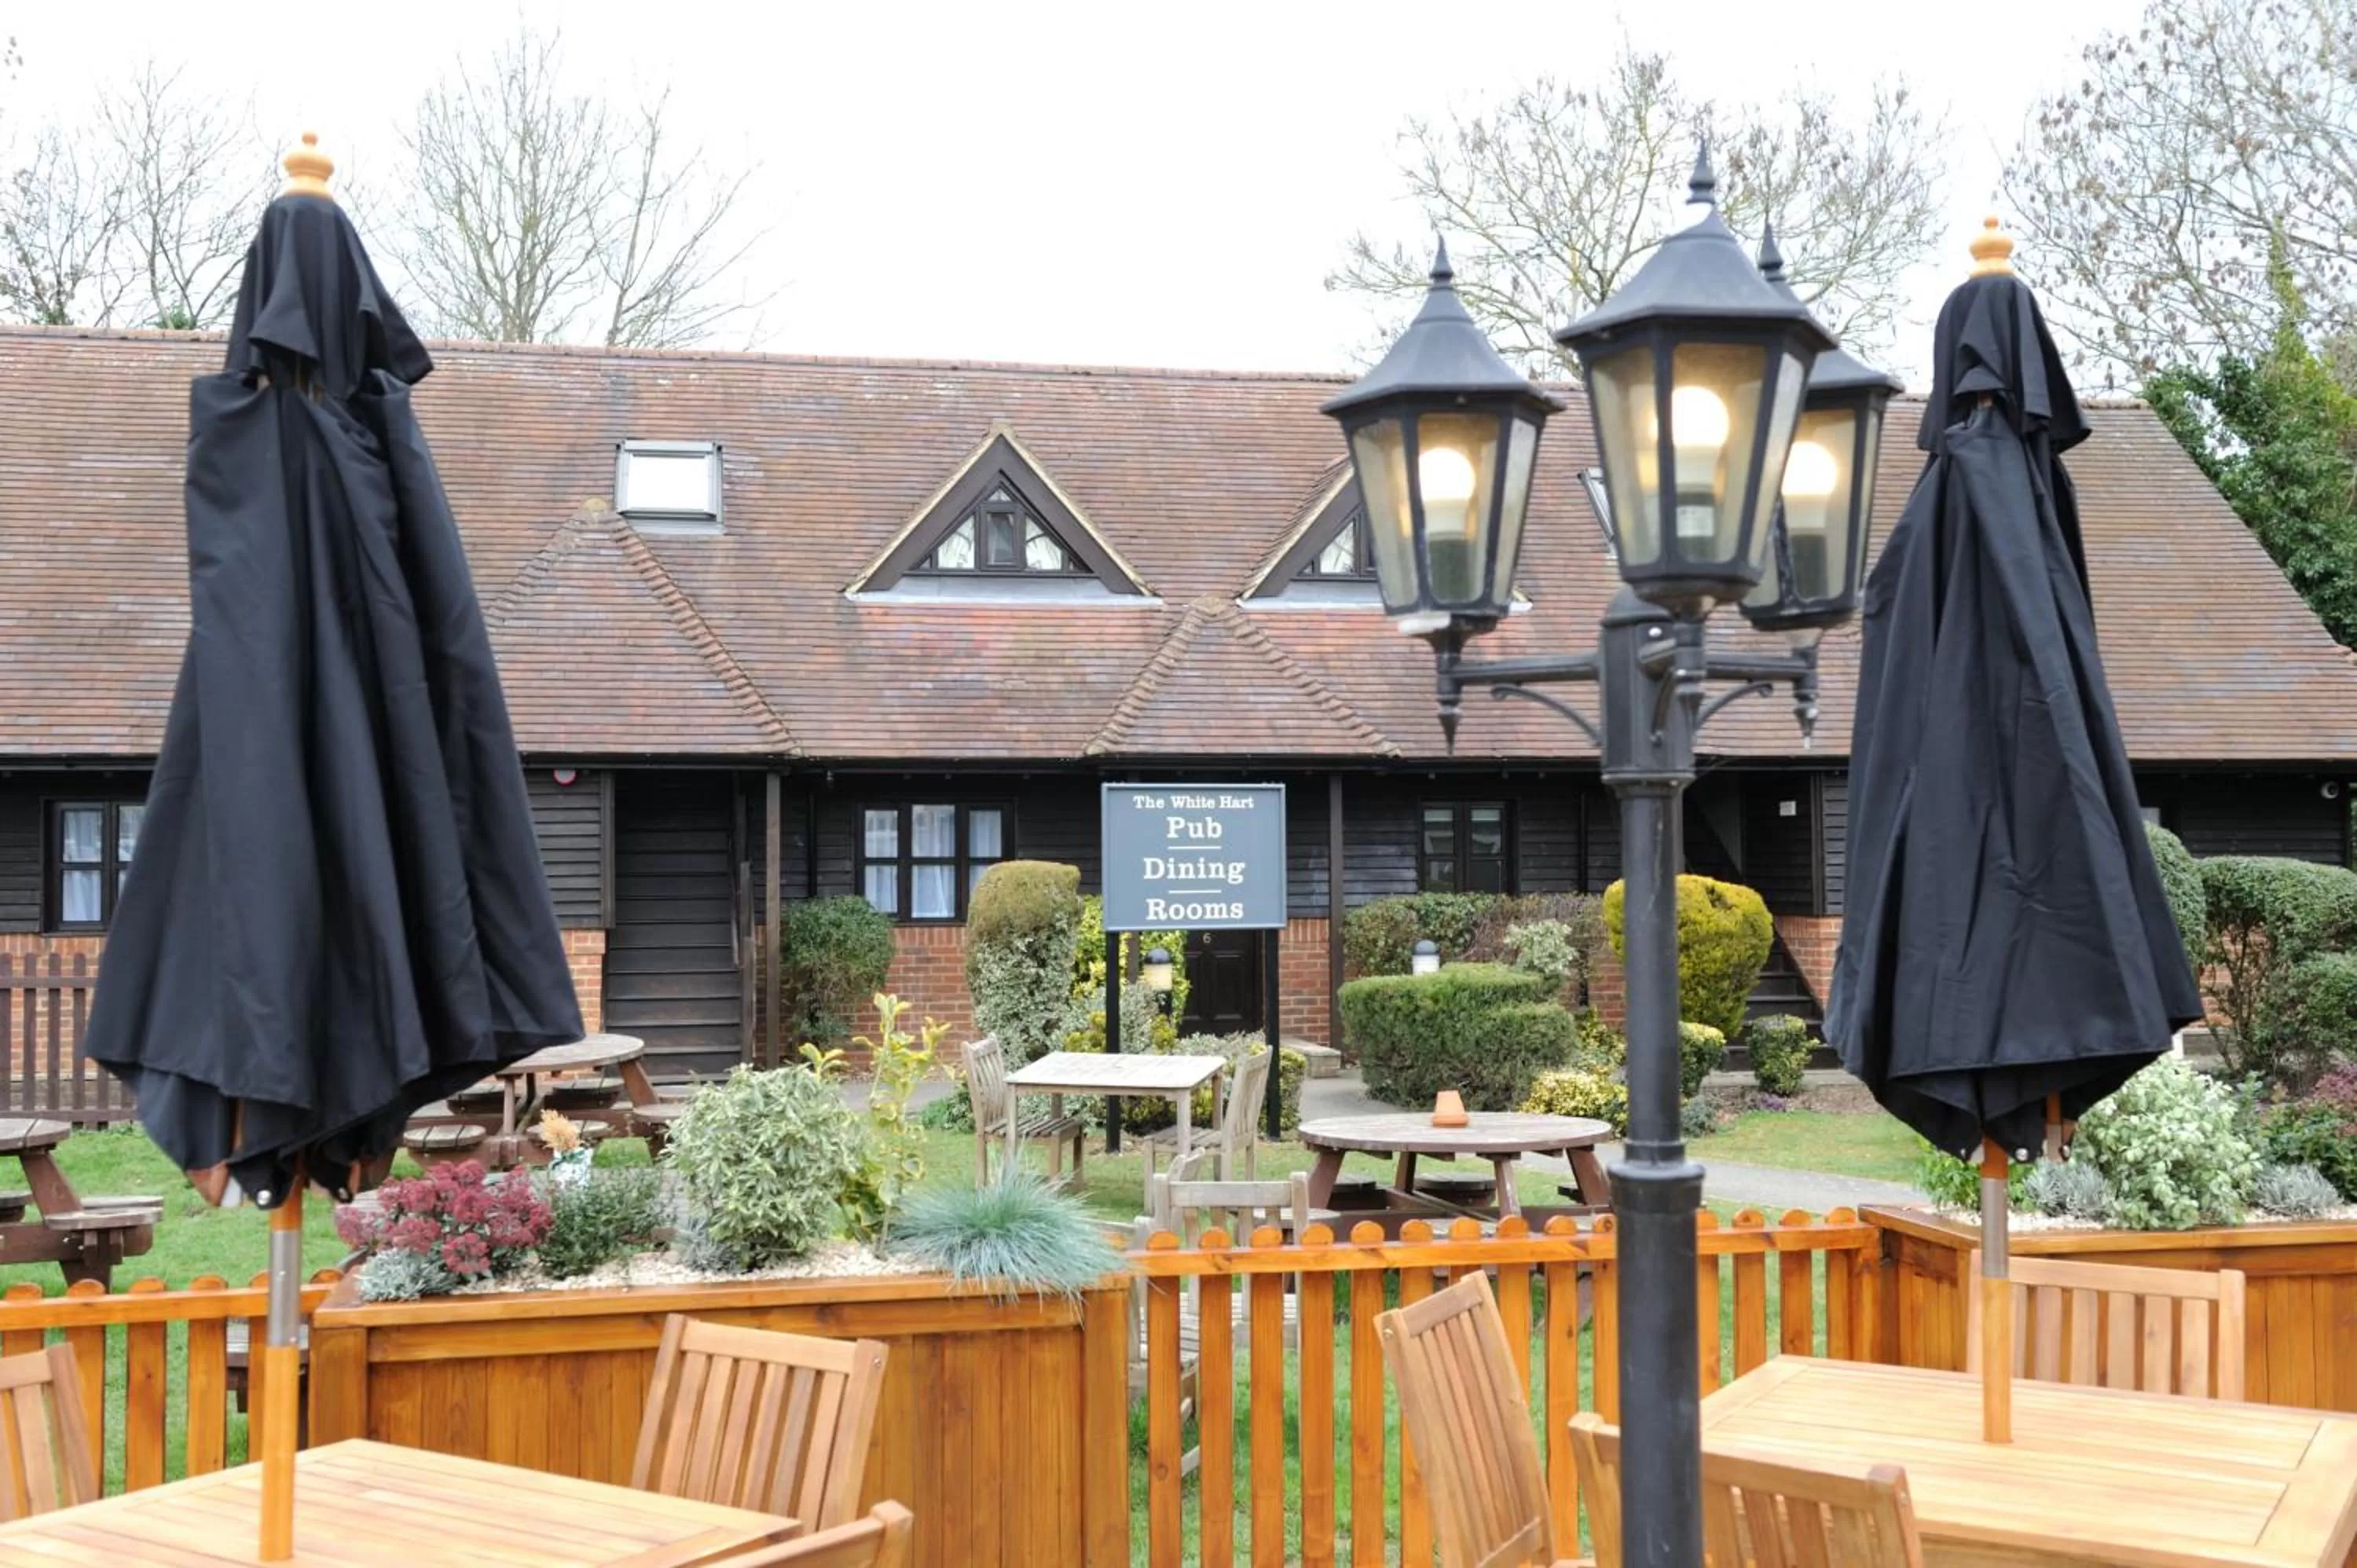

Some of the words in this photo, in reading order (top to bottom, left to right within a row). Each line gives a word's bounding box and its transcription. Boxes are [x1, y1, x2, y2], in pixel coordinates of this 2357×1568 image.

[1132, 795, 1165, 809] The
[1170, 795, 1215, 809] White
[1219, 795, 1255, 809] Hart
[1166, 816, 1222, 839] Pub
[1143, 857, 1246, 885] Dining
[1146, 898, 1244, 921] Rooms
[1202, 932, 1211, 943] 6
